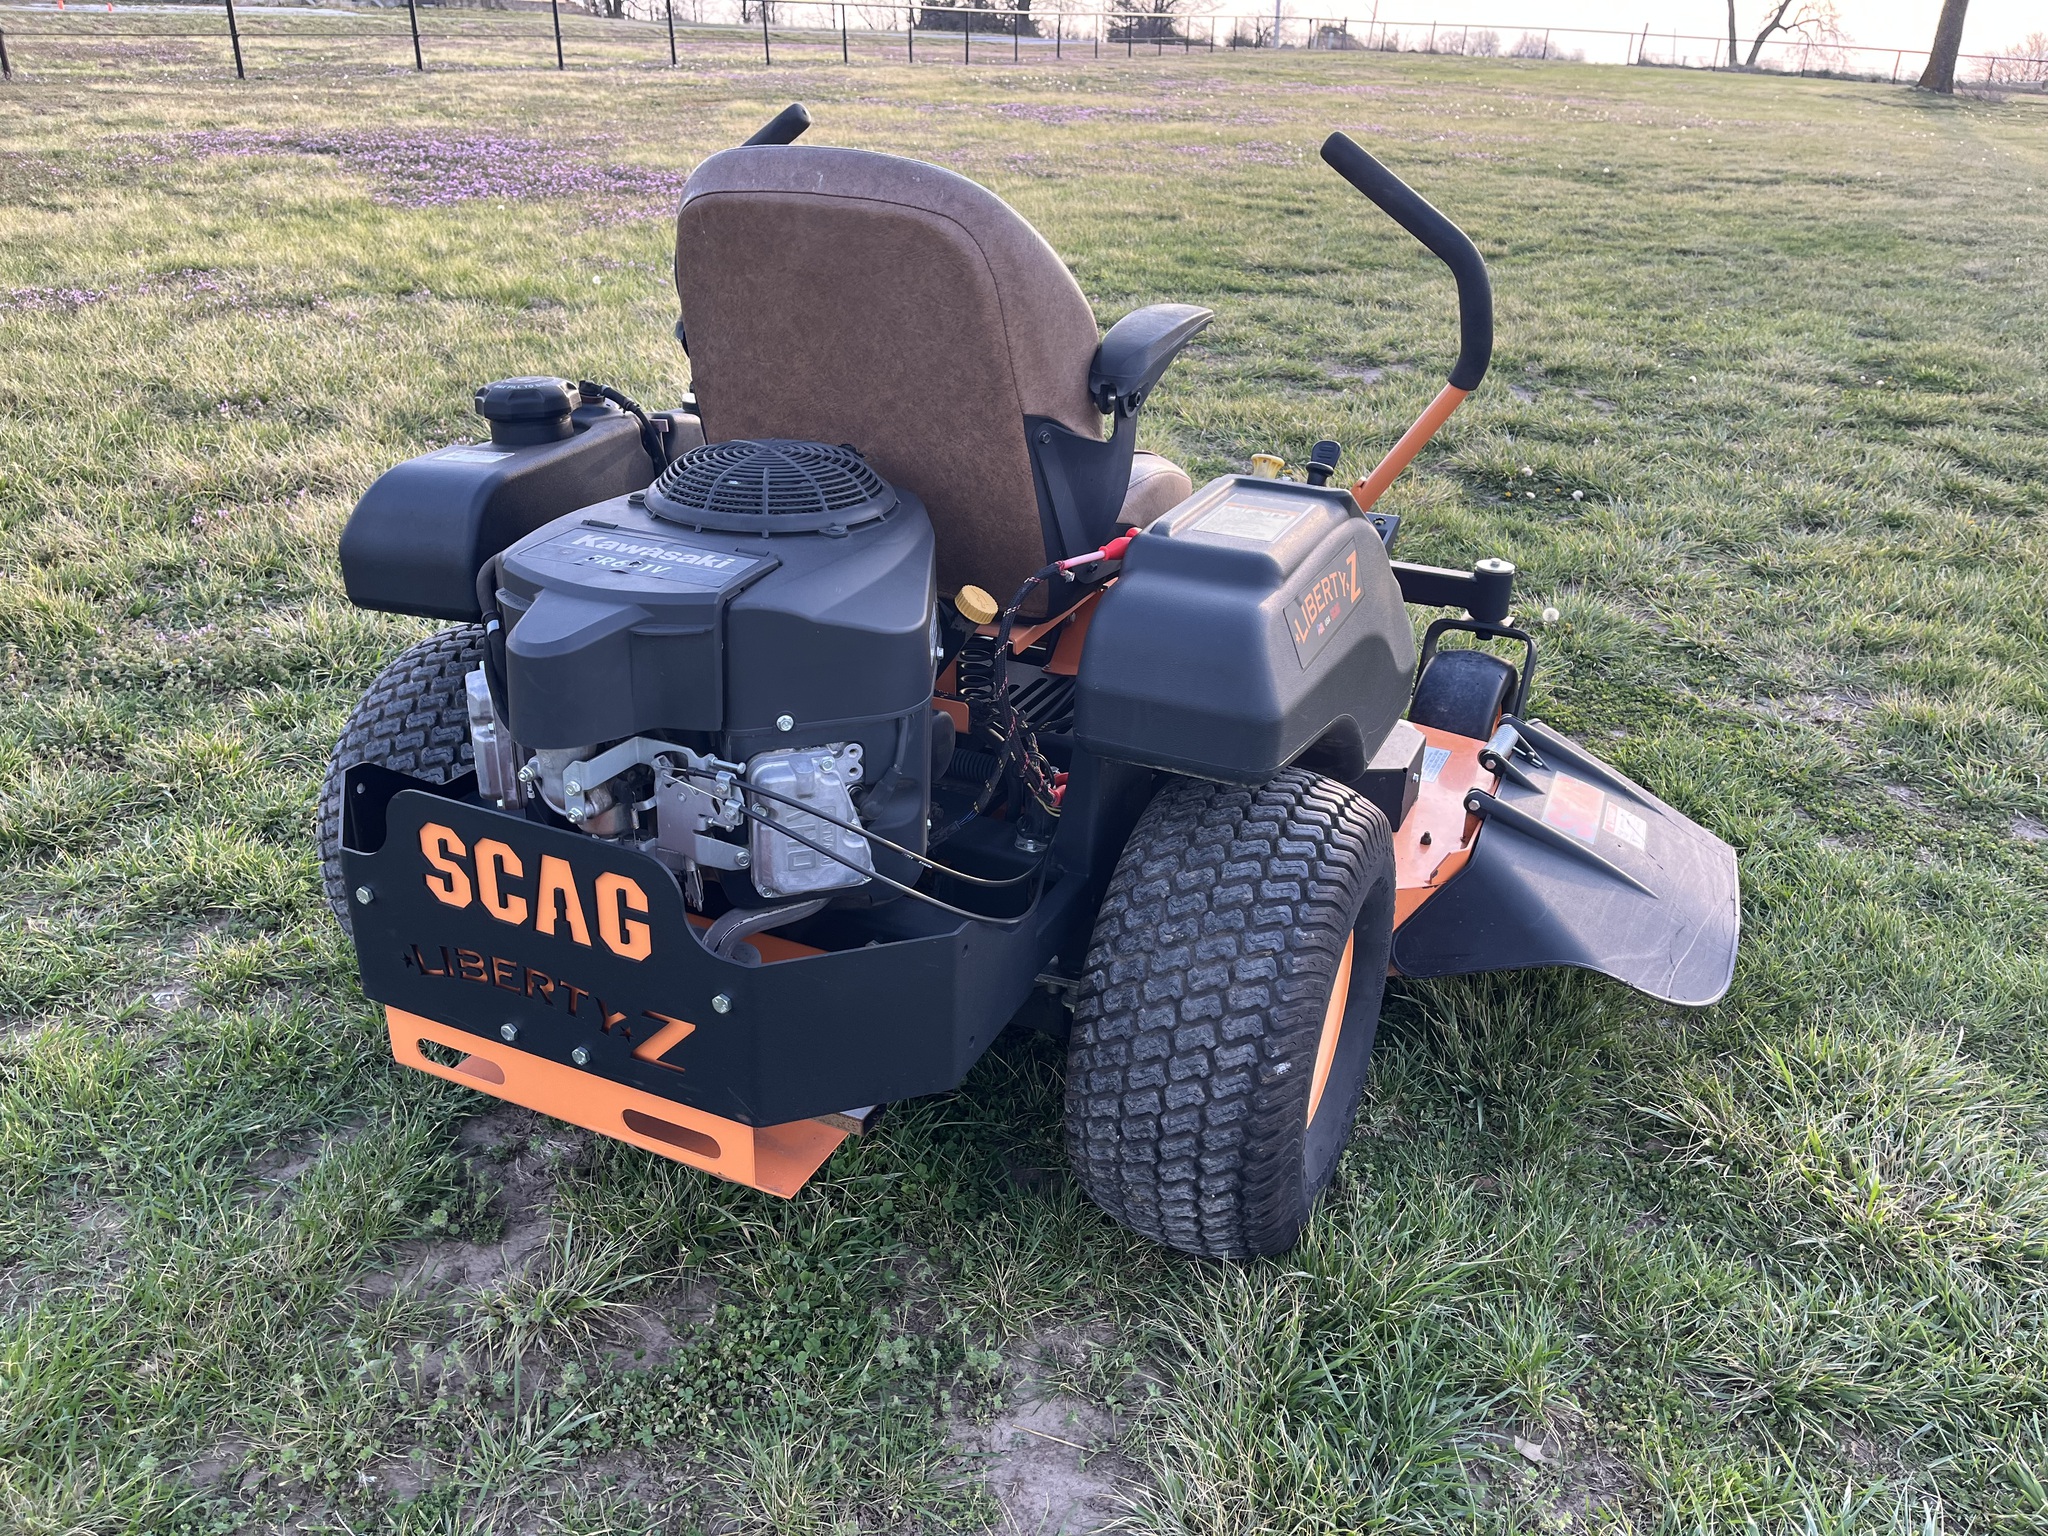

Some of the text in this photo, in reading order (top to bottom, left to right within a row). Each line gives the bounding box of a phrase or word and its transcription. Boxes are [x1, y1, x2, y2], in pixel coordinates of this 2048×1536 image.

[571, 534, 736, 569] Kawasaki
[1294, 550, 1362, 644] LIBERTY Z
[417, 821, 652, 963] SCAG
[411, 944, 696, 1073] LIBERTY Z
